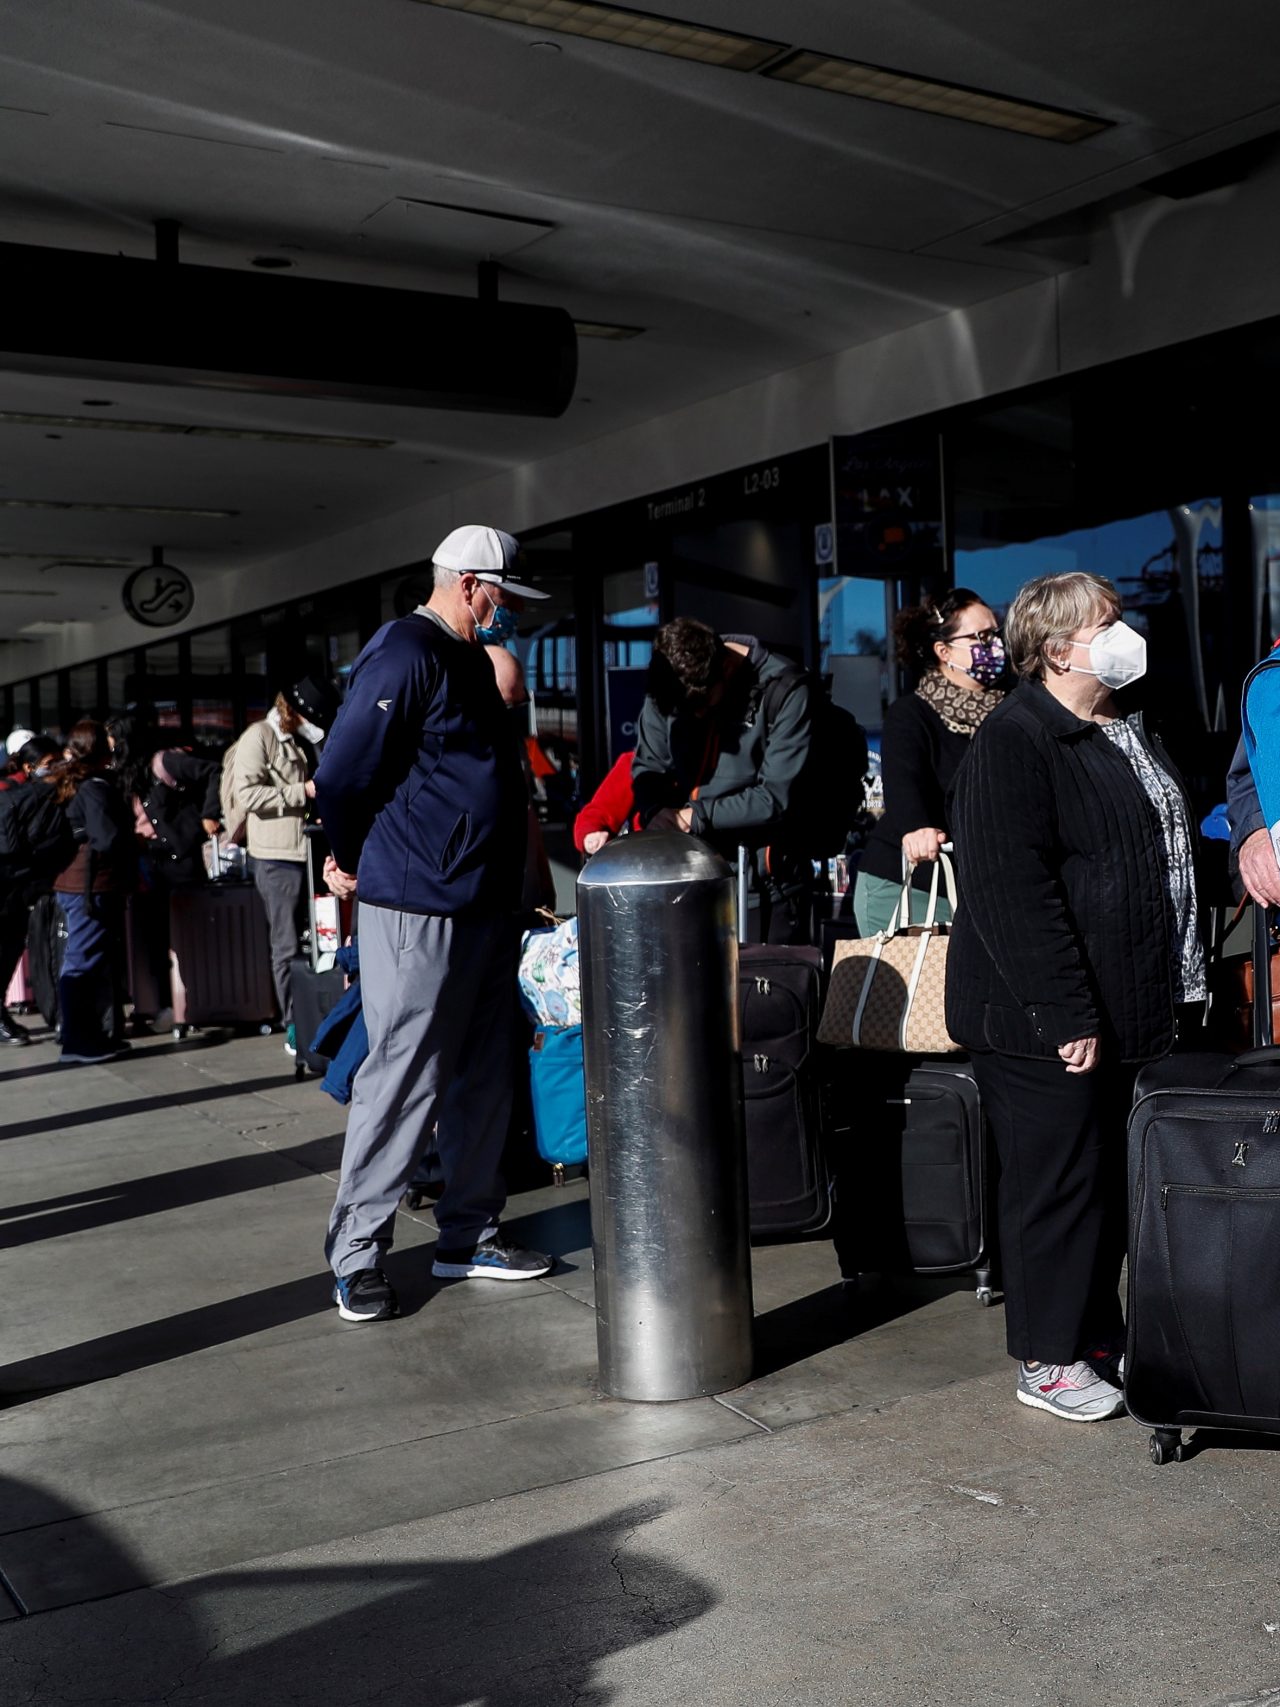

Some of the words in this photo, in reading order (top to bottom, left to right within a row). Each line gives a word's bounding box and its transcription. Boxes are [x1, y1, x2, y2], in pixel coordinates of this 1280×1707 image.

[743, 465, 781, 495] L2-03
[647, 490, 695, 521] Terminal
[697, 487, 706, 508] 2
